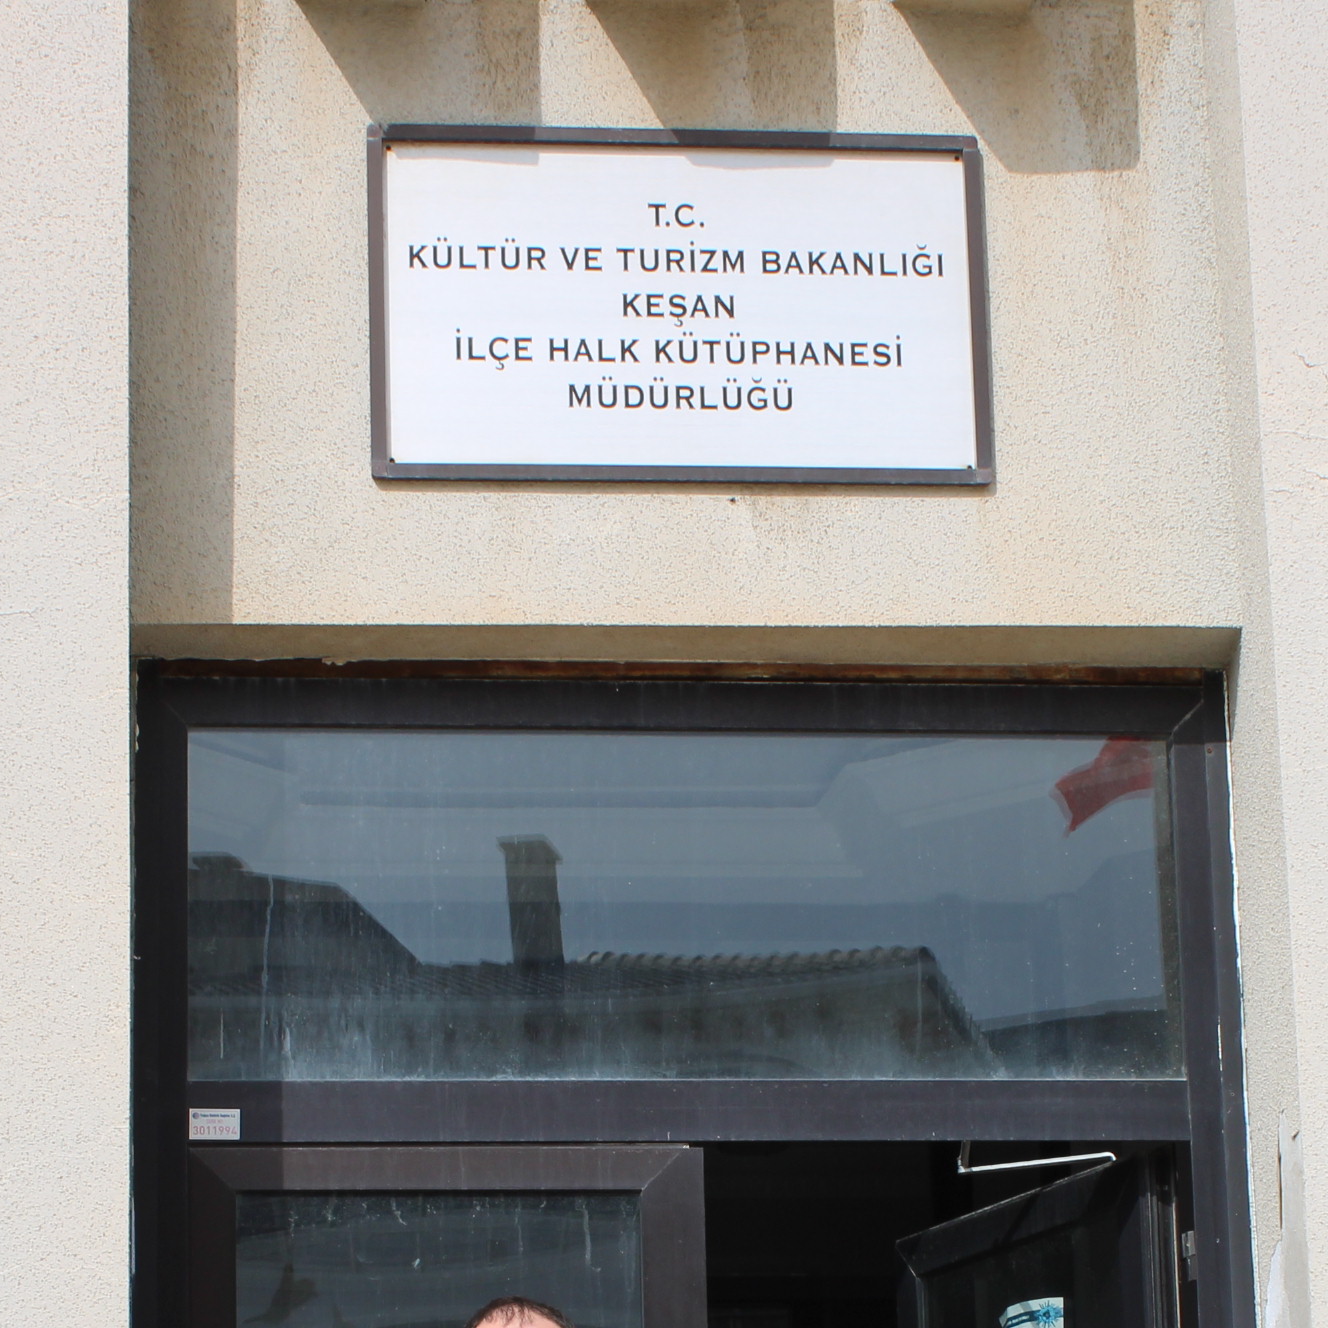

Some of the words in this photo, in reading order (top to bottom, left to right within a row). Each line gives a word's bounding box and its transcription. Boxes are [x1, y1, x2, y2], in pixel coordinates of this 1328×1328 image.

[648, 203, 705, 228] T.C.
[407, 237, 547, 271] KÜLTÜR
[560, 246, 604, 272] VE
[616, 241, 746, 275] TURİZM
[761, 244, 945, 278] BAKANLIĞI
[622, 293, 736, 327] KEŞAN
[455, 329, 533, 370] İLÇE
[549, 338, 640, 364] HALK
[654, 333, 904, 368] KÜTÜPHANESİ
[568, 377, 795, 411] MÜDÜRLÜĞÜ
